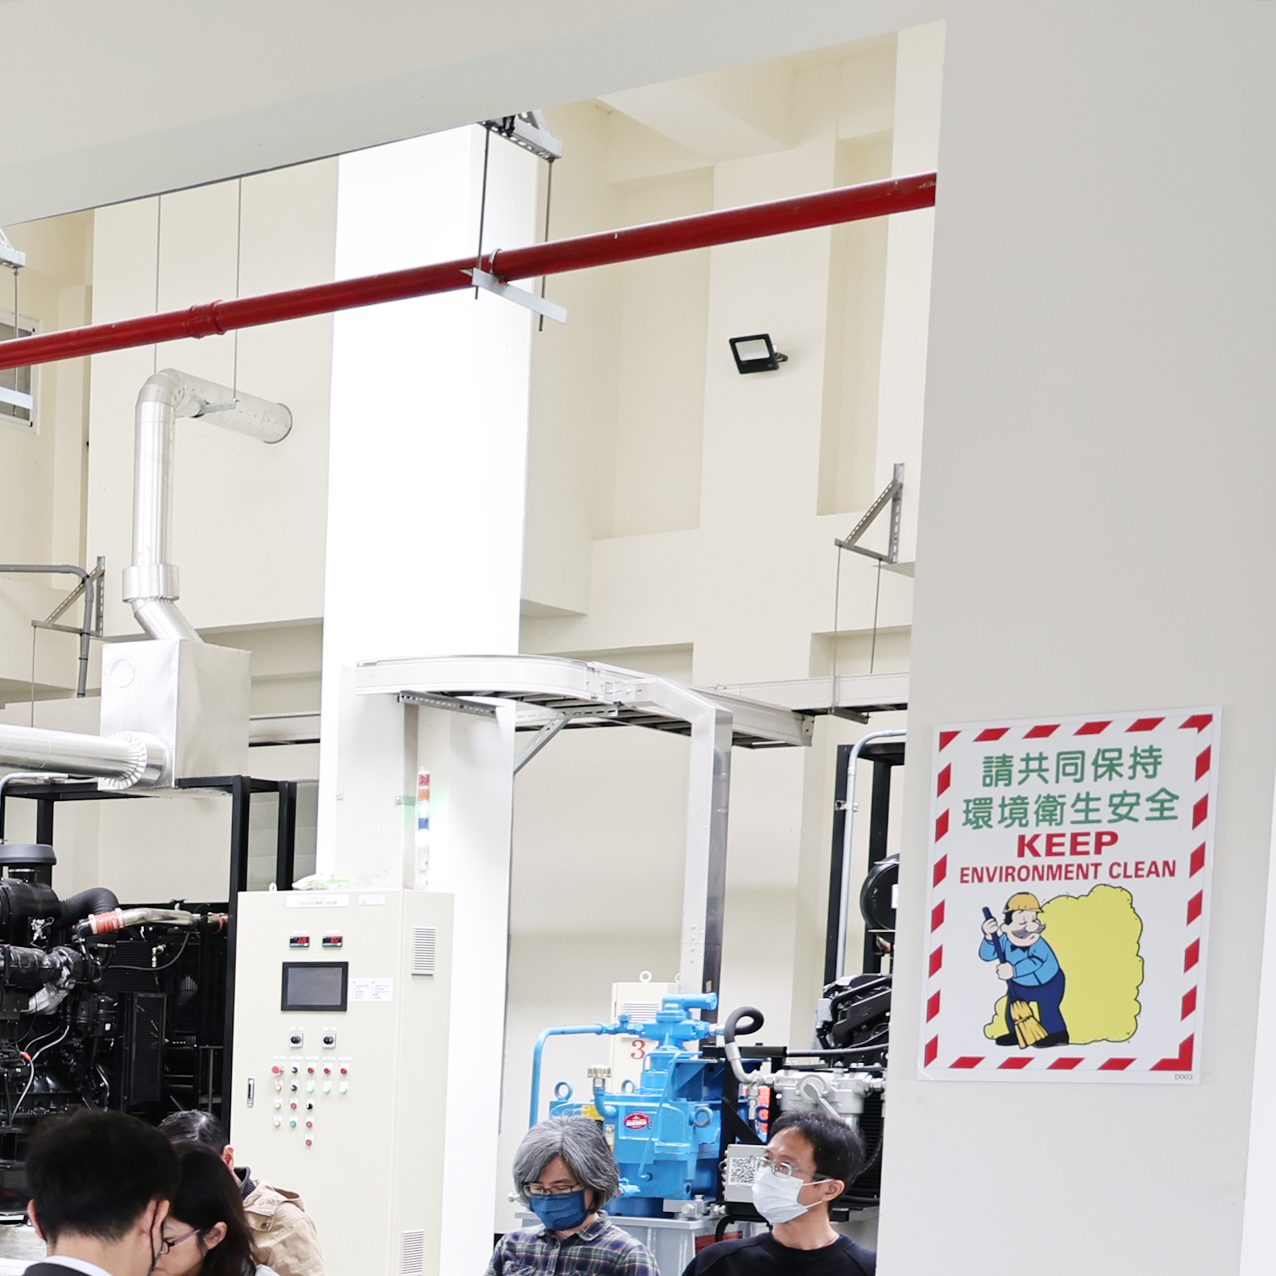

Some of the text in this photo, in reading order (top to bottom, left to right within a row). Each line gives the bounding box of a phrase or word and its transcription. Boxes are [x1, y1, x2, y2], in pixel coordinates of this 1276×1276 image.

[982, 744, 1163, 788] 請共同保持
[962, 787, 1180, 830] 環境衛生安全
[1016, 830, 1119, 858] KEEP
[959, 859, 1177, 884] ENVIRONMENT CLEAN
[630, 1039, 646, 1060] 3
